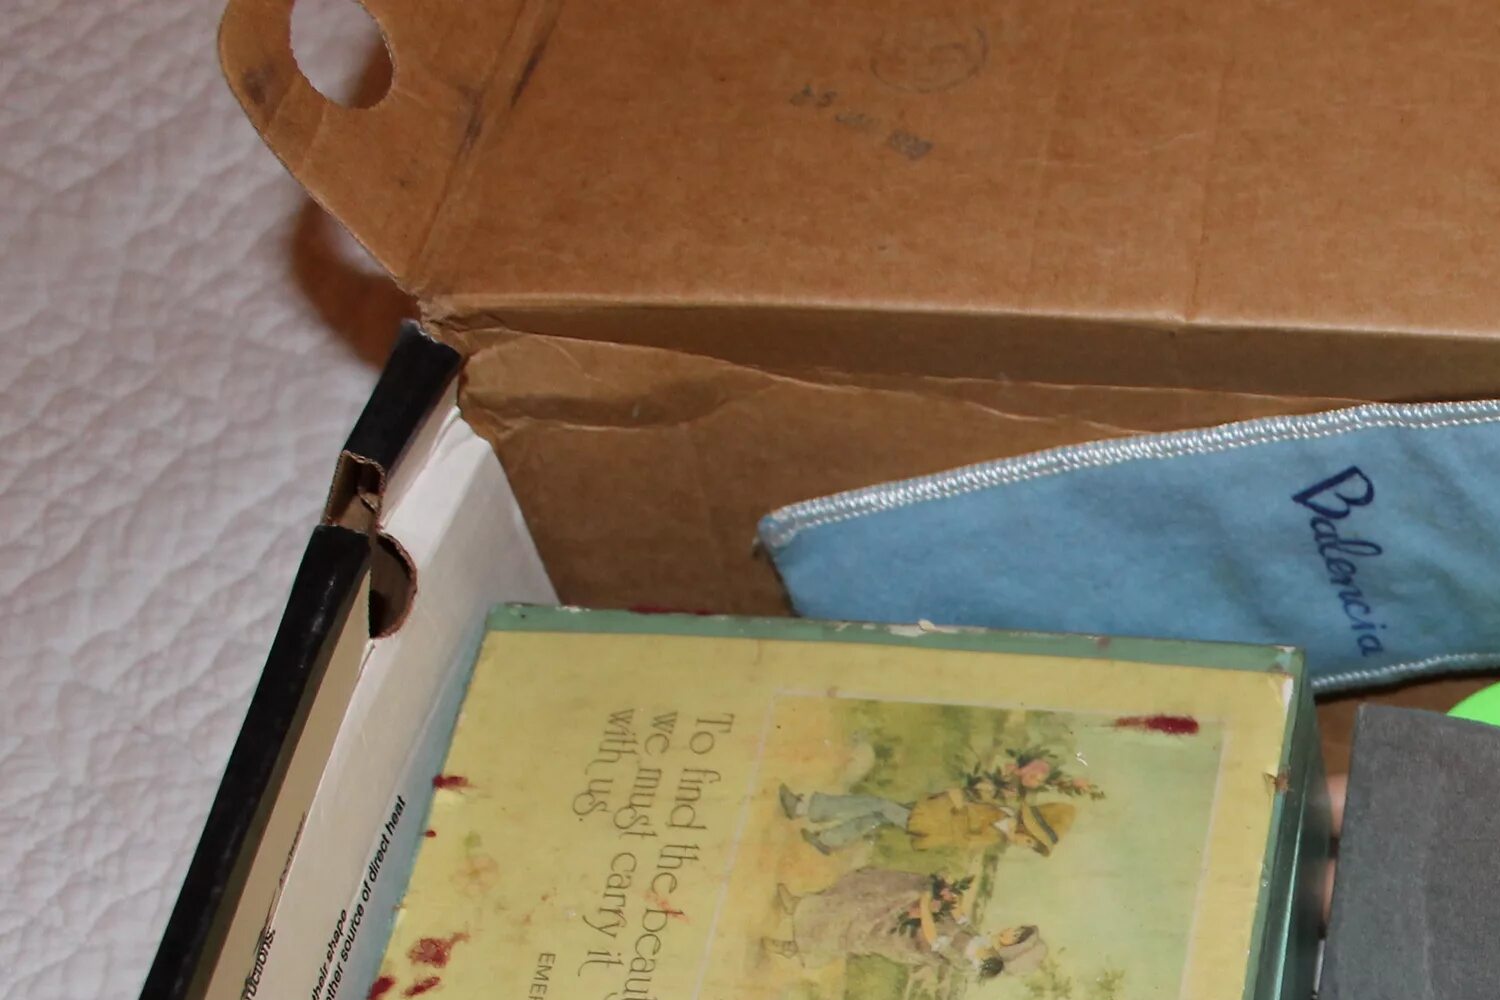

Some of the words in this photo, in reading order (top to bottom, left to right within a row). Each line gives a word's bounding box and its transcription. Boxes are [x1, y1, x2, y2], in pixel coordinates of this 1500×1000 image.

[584, 707, 640, 776] with
[644, 710, 678, 756] we
[689, 712, 736, 756] To
[572, 777, 614, 823] us.
[612, 767, 662, 840] must
[666, 767, 722, 831] find
[340, 908, 363, 961] source
[359, 884, 371, 900] of
[366, 834, 391, 878] direct
[383, 798, 405, 832] heat
[582, 851, 637, 938] carry
[650, 843, 701, 895] the
[311, 964, 329, 1000] their
[325, 911, 347, 961] shape
[577, 949, 624, 977] it
